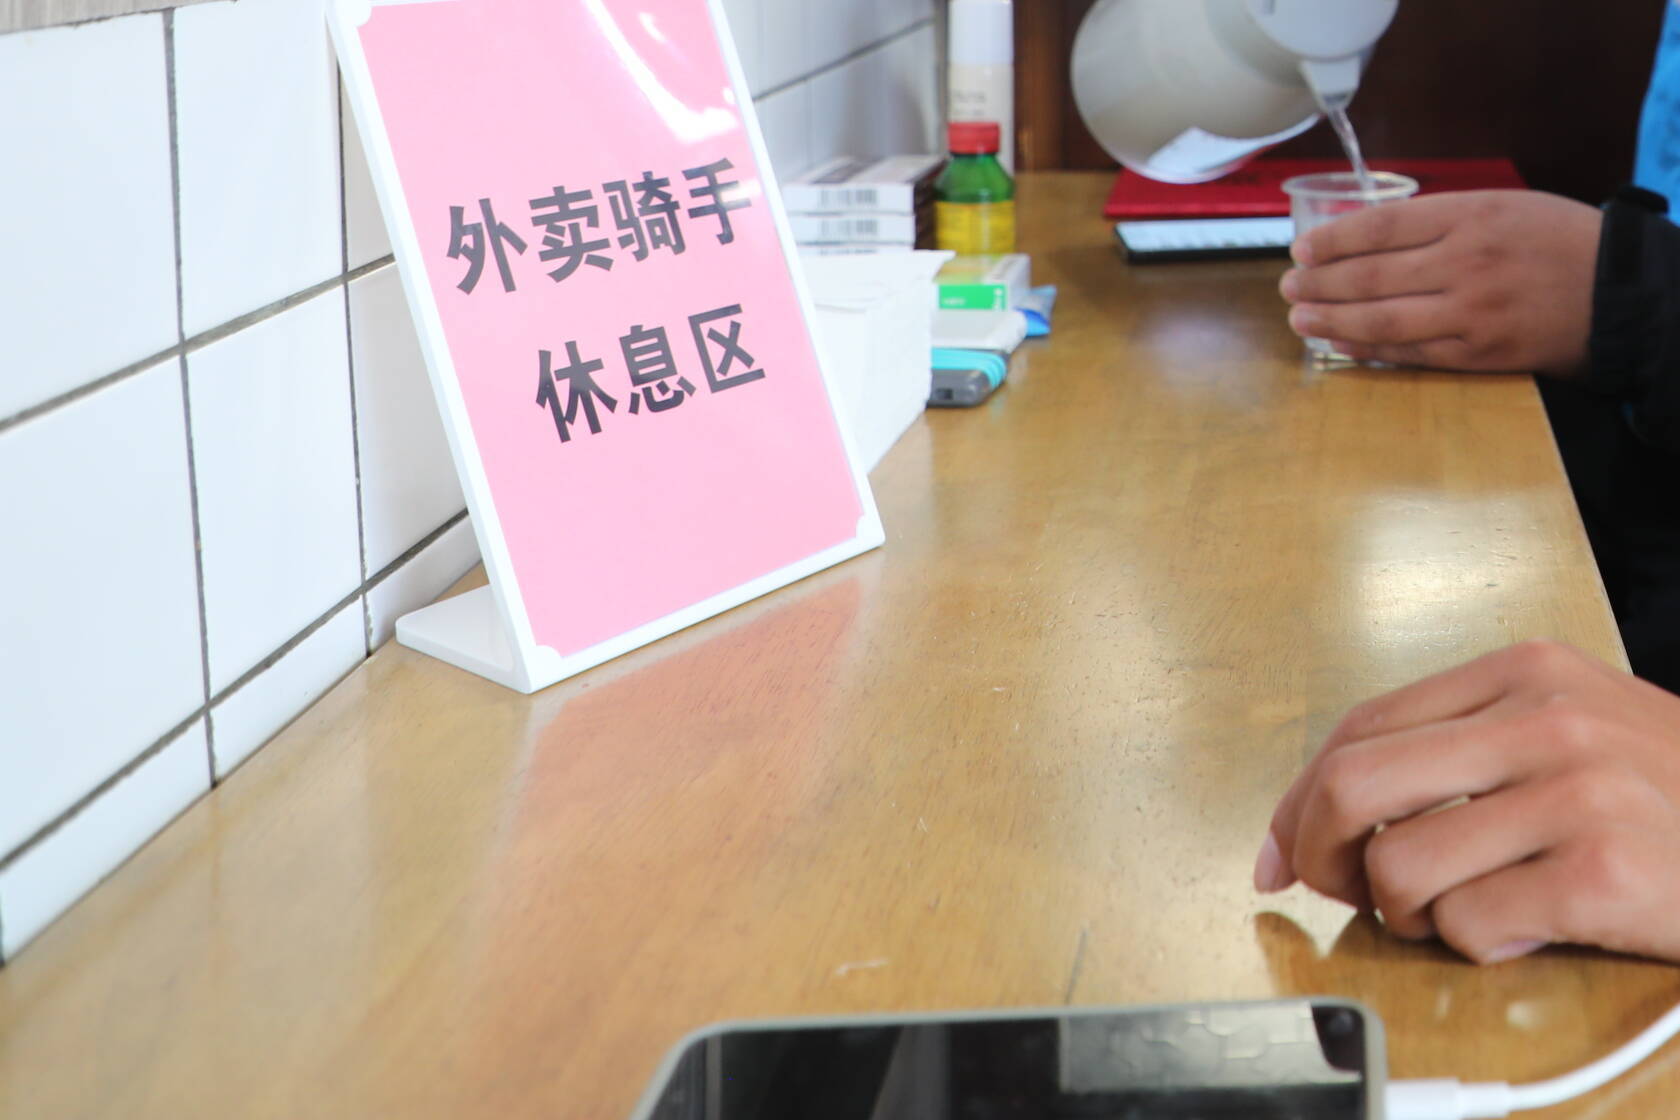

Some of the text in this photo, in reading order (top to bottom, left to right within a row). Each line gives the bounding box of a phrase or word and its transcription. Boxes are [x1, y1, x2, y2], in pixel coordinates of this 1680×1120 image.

[446, 158, 753, 296] 外卖骑手
[534, 303, 765, 442] 休息区
